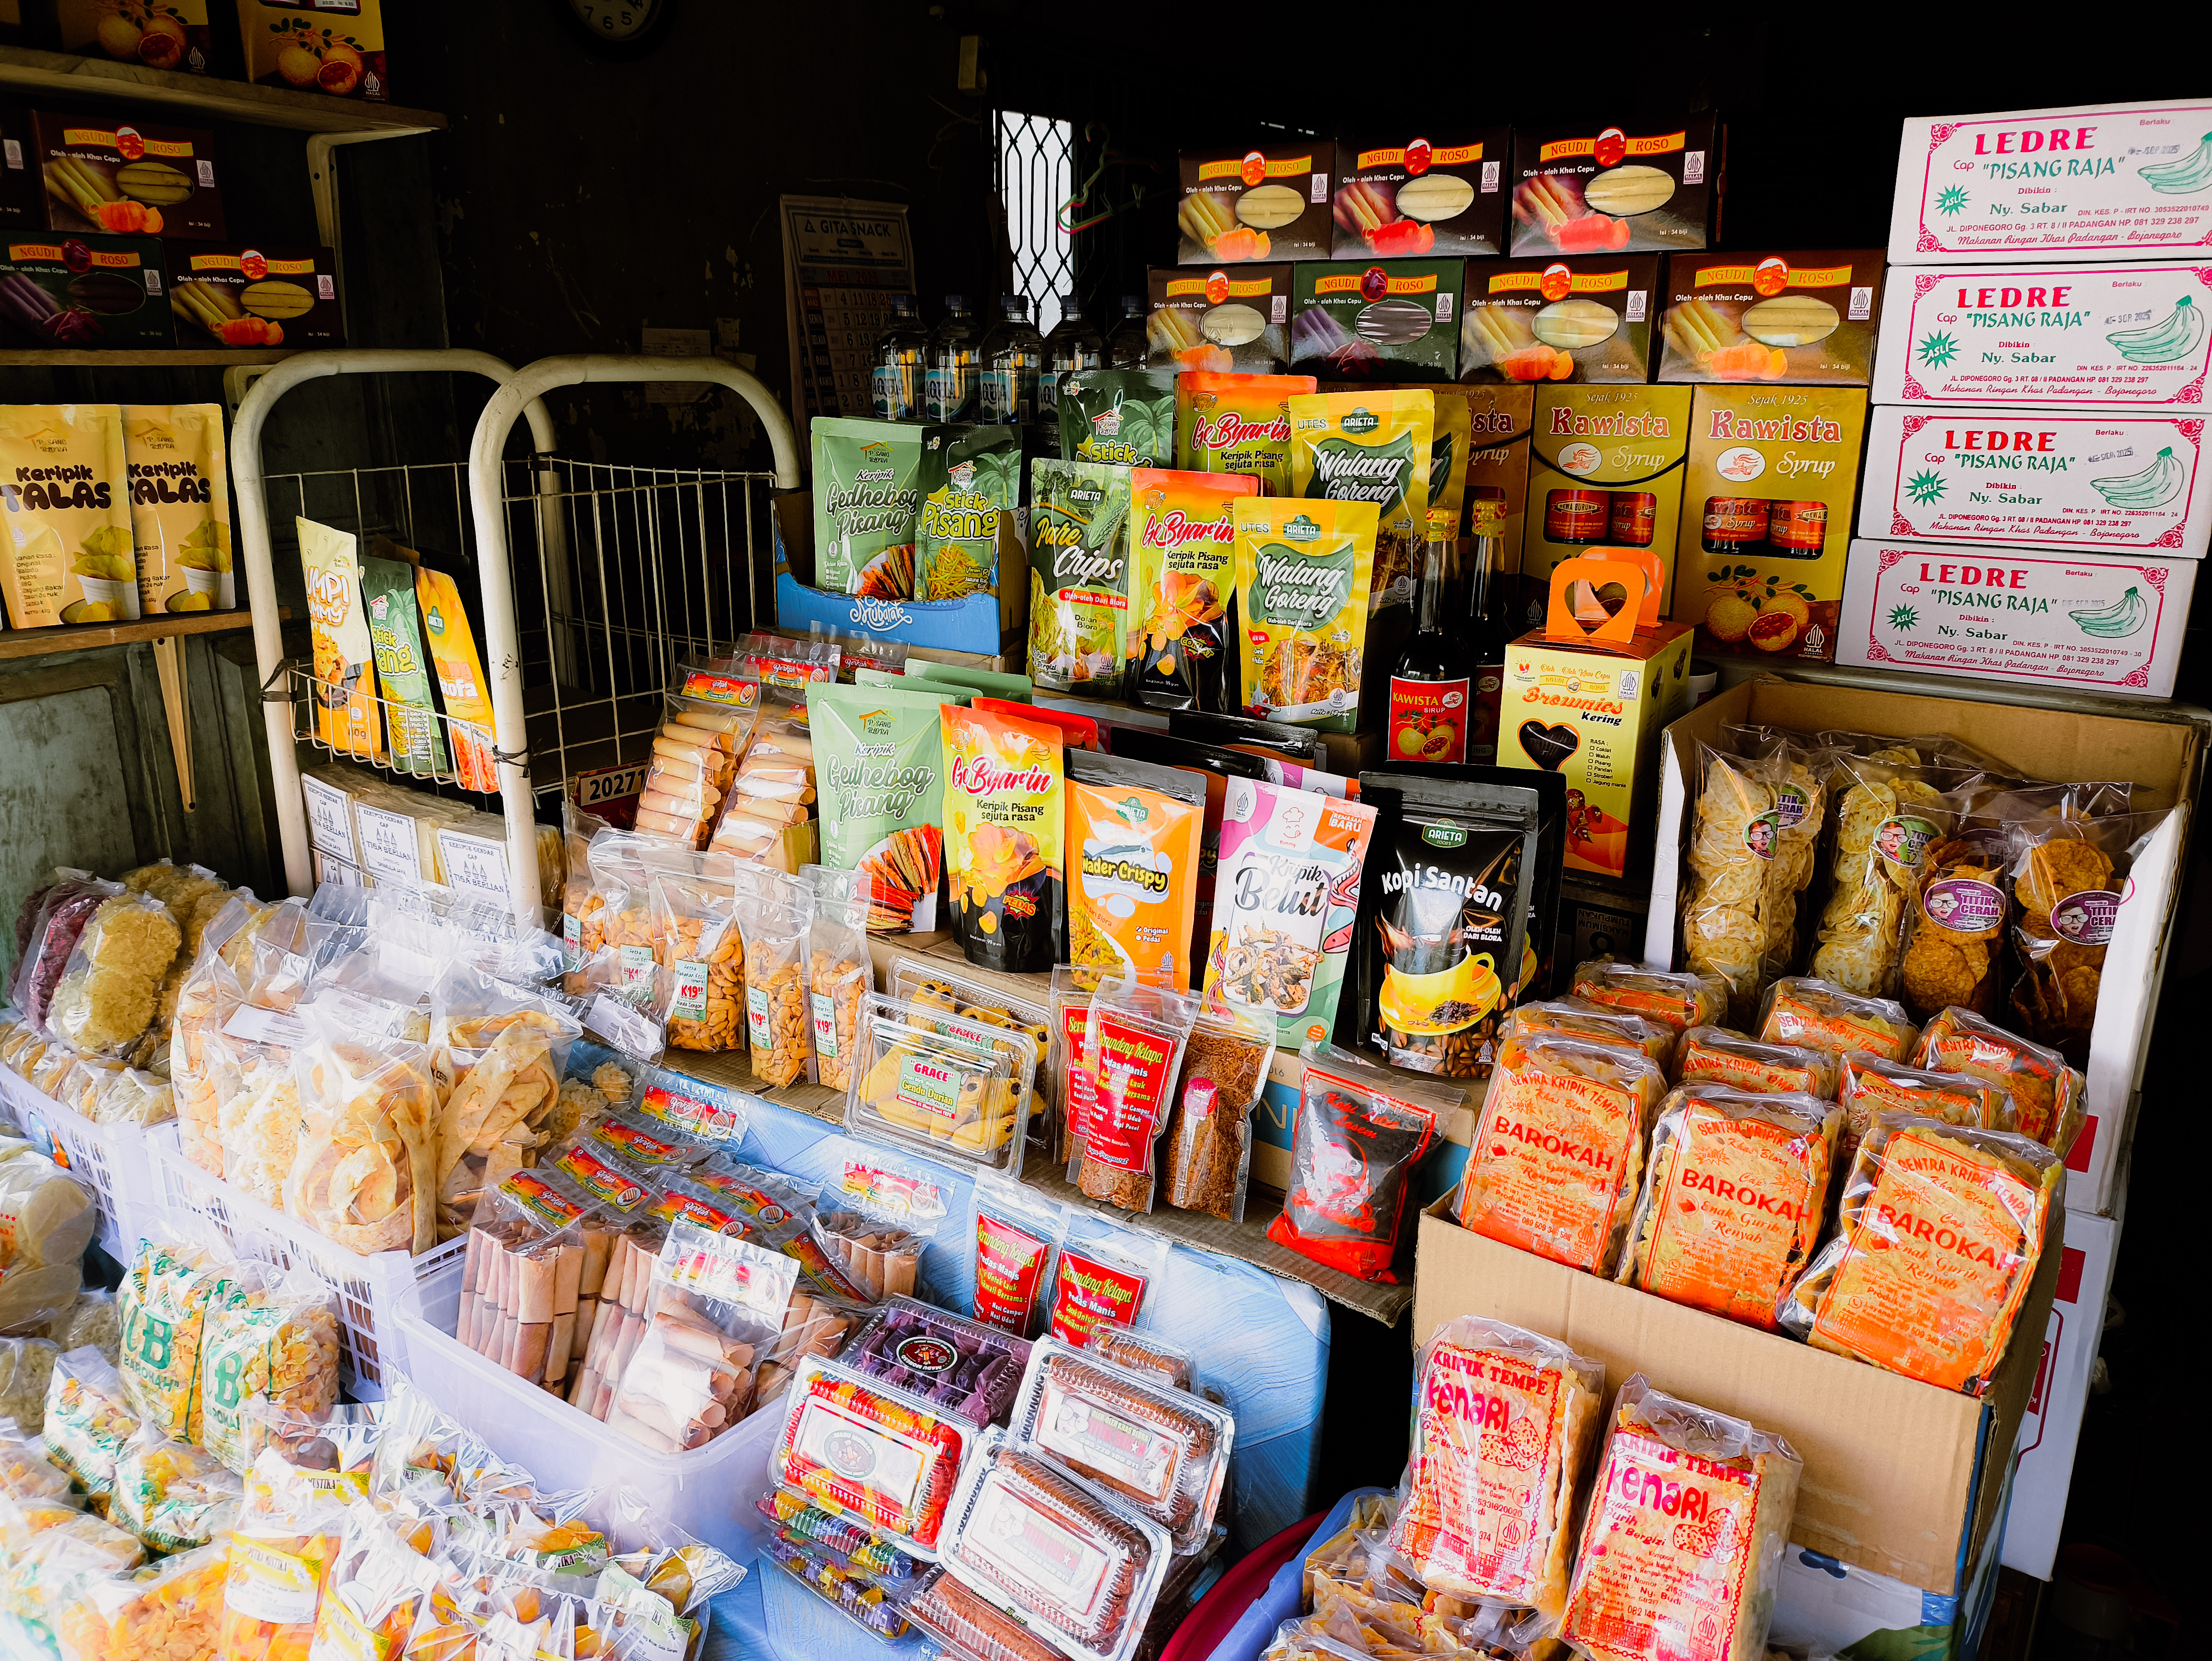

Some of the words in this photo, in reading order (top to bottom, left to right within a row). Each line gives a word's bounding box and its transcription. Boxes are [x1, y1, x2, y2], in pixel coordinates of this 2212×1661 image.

[603, 15, 614, 30] 6
[621, 12, 632, 25] 5
[74, 131, 110, 144] NGUDI
[153, 143, 181, 155] ROSO
[1550, 142, 1588, 155] NGUDI
[1636, 139, 1669, 151] ROSO
[1974, 127, 2098, 155] LEDRE
[1367, 152, 1399, 164] NGUDI
[1440, 148, 1469, 161] ROSO
[1207, 165, 1236, 175] NGUDI
[1273, 163, 1299, 173] ROSO
[1577, 165, 1594, 173] Cepu
[1954, 160, 1975, 171] Cap
[1990, 204, 2013, 216] Ny.
[2020, 203, 2068, 214] Sabar
[820, 220, 849, 234] GITA
[851, 221, 891, 237] SNACK
[20, 247, 56, 259] NGUDI
[100, 255, 129, 266] ROSO
[200, 256, 234, 268] NGUDI
[275, 261, 302, 272] ROSO
[827, 269, 849, 283] MEI
[856, 272, 878, 283] 2025
[1324, 279, 1355, 289] NGUDI
[1395, 280, 1423, 290] ROSO
[1499, 277, 1534, 288] NGUDI
[1581, 277, 1612, 288] ROSO
[1707, 270, 1747, 282] NGUDI
[1798, 272, 1834, 284] ROSO
[1958, 287, 2072, 308] LEDRE
[1585, 392, 1612, 403] Sejak
[1614, 393, 1638, 402] 1925
[1551, 408, 1670, 438] Kawista
[1709, 410, 1842, 443] Kawista
[1945, 430, 2057, 452] LEDRE
[1090, 444, 1138, 463] Stick
[1612, 445, 1665, 472] Syrup
[1925, 453, 1945, 464] Cap
[1318, 449, 1404, 480] Walang
[1777, 451, 1836, 478] Syrup
[16, 465, 94, 484] Keripik
[0, 481, 111, 512] TALAS
[944, 492, 986, 509] Stick
[1071, 488, 1101, 502] ARIETA
[1969, 492, 1992, 503] Ny.
[1998, 493, 2043, 505] Sabar
[922, 504, 999, 540] Pisang
[1239, 522, 1269, 534] UTES
[1287, 524, 1316, 536] ARIETA
[1929, 522, 1970, 531] Makanan
[1974, 524, 2005, 534] Ringan
[2008, 525, 2030, 533] Khas
[2034, 526, 2078, 537] Padangan
[2090, 529, 2139, 540] Bojonegoro
[1036, 517, 1082, 547] Pare
[1053, 545, 1123, 582] Crips
[1260, 556, 1343, 589] Walang
[1919, 563, 2028, 589] LEDRE
[1064, 592, 1093, 602] Oleh-oleh
[1095, 596, 1108, 604] Dari
[1110, 598, 1126, 607] Blora
[1265, 585, 1338, 620] Goreng
[1897, 614, 1912, 623] ASLI
[773, 663, 795, 674] Berkah
[1393, 692, 1438, 706] KAWISTA
[1523, 687, 1623, 714] Brownies
[1582, 711, 1622, 726] Kering
[855, 742, 895, 758] Keripik
[825, 754, 935, 796] Gedhebog
[589, 769, 646, 801] 20271
[838, 787, 915, 824] Pisang
[976, 799, 1008, 813] Keripik
[1011, 803, 1044, 816] Pisang
[982, 811, 1009, 821] sejuta
[1012, 813, 1036, 822] rasa
[1330, 818, 1361, 832] BARU
[1333, 813, 1363, 823] KEMASAN
[1428, 829, 1462, 842] ARIETA
[1082, 855, 1115, 878] Wader
[1118, 865, 1169, 892] Crispy
[453, 874, 471, 884] TIGA
[473, 879, 504, 893] BERLIAN
[1235, 867, 1329, 917] Belut
[1382, 864, 1421, 894] Kopi
[1426, 867, 1502, 911] Santan
[1003, 894, 1036, 916] PEDAS
[1961, 896, 1994, 907] TITIK
[1578, 909, 1630, 927] TUMPUKAN
[1961, 906, 1999, 917] CERAH
[1143, 927, 1168, 935] Original
[1463, 932, 1478, 941] DARI
[1480, 934, 1502, 942] BLORA
[1466, 926, 1501, 935] OLEH-OLEH
[1578, 919, 1629, 937] MAKSIMUM
[1100, 1030, 1134, 1059] Serundeng
[1134, 1042, 1163, 1066] Kelapa
[1102, 1056, 1121, 1071] Pedas
[1122, 1063, 1148, 1077] Manis
[1111, 1073, 1128, 1085] Untuk
[1129, 1079, 1146, 1089] Lauk
[902, 1080, 926, 1096] Gendu
[927, 1088, 953, 1106] Durian
[670, 1097, 696, 1113] Berkah
[1117, 1101, 1128, 1110] Nasi
[1129, 1105, 1150, 1115] Campur
[634, 1136, 659, 1150] Berkah
[1495, 1116, 1614, 1172] BAROKAH
[1681, 1168, 1814, 1225] BAROKAH
[1898, 1157, 1946, 1172] SENTRA
[1951, 1163, 1994, 1191] KRIPIK
[1995, 1184, 2030, 1218] TEMPE
[1930, 1176, 1958, 1194] Khas
[1964, 1191, 1995, 1210] Blora
[1877, 1204, 2019, 1276] BAROKAH
[1062, 1262, 1102, 1297] Serundeng
[1102, 1278, 1133, 1306] Kelapa
[1068, 1291, 1087, 1307] Pedas
[1089, 1300, 1116, 1318] Manis
[1434, 1351, 1485, 1378] KRIPIK
[1490, 1366, 1548, 1395] TEMPE
